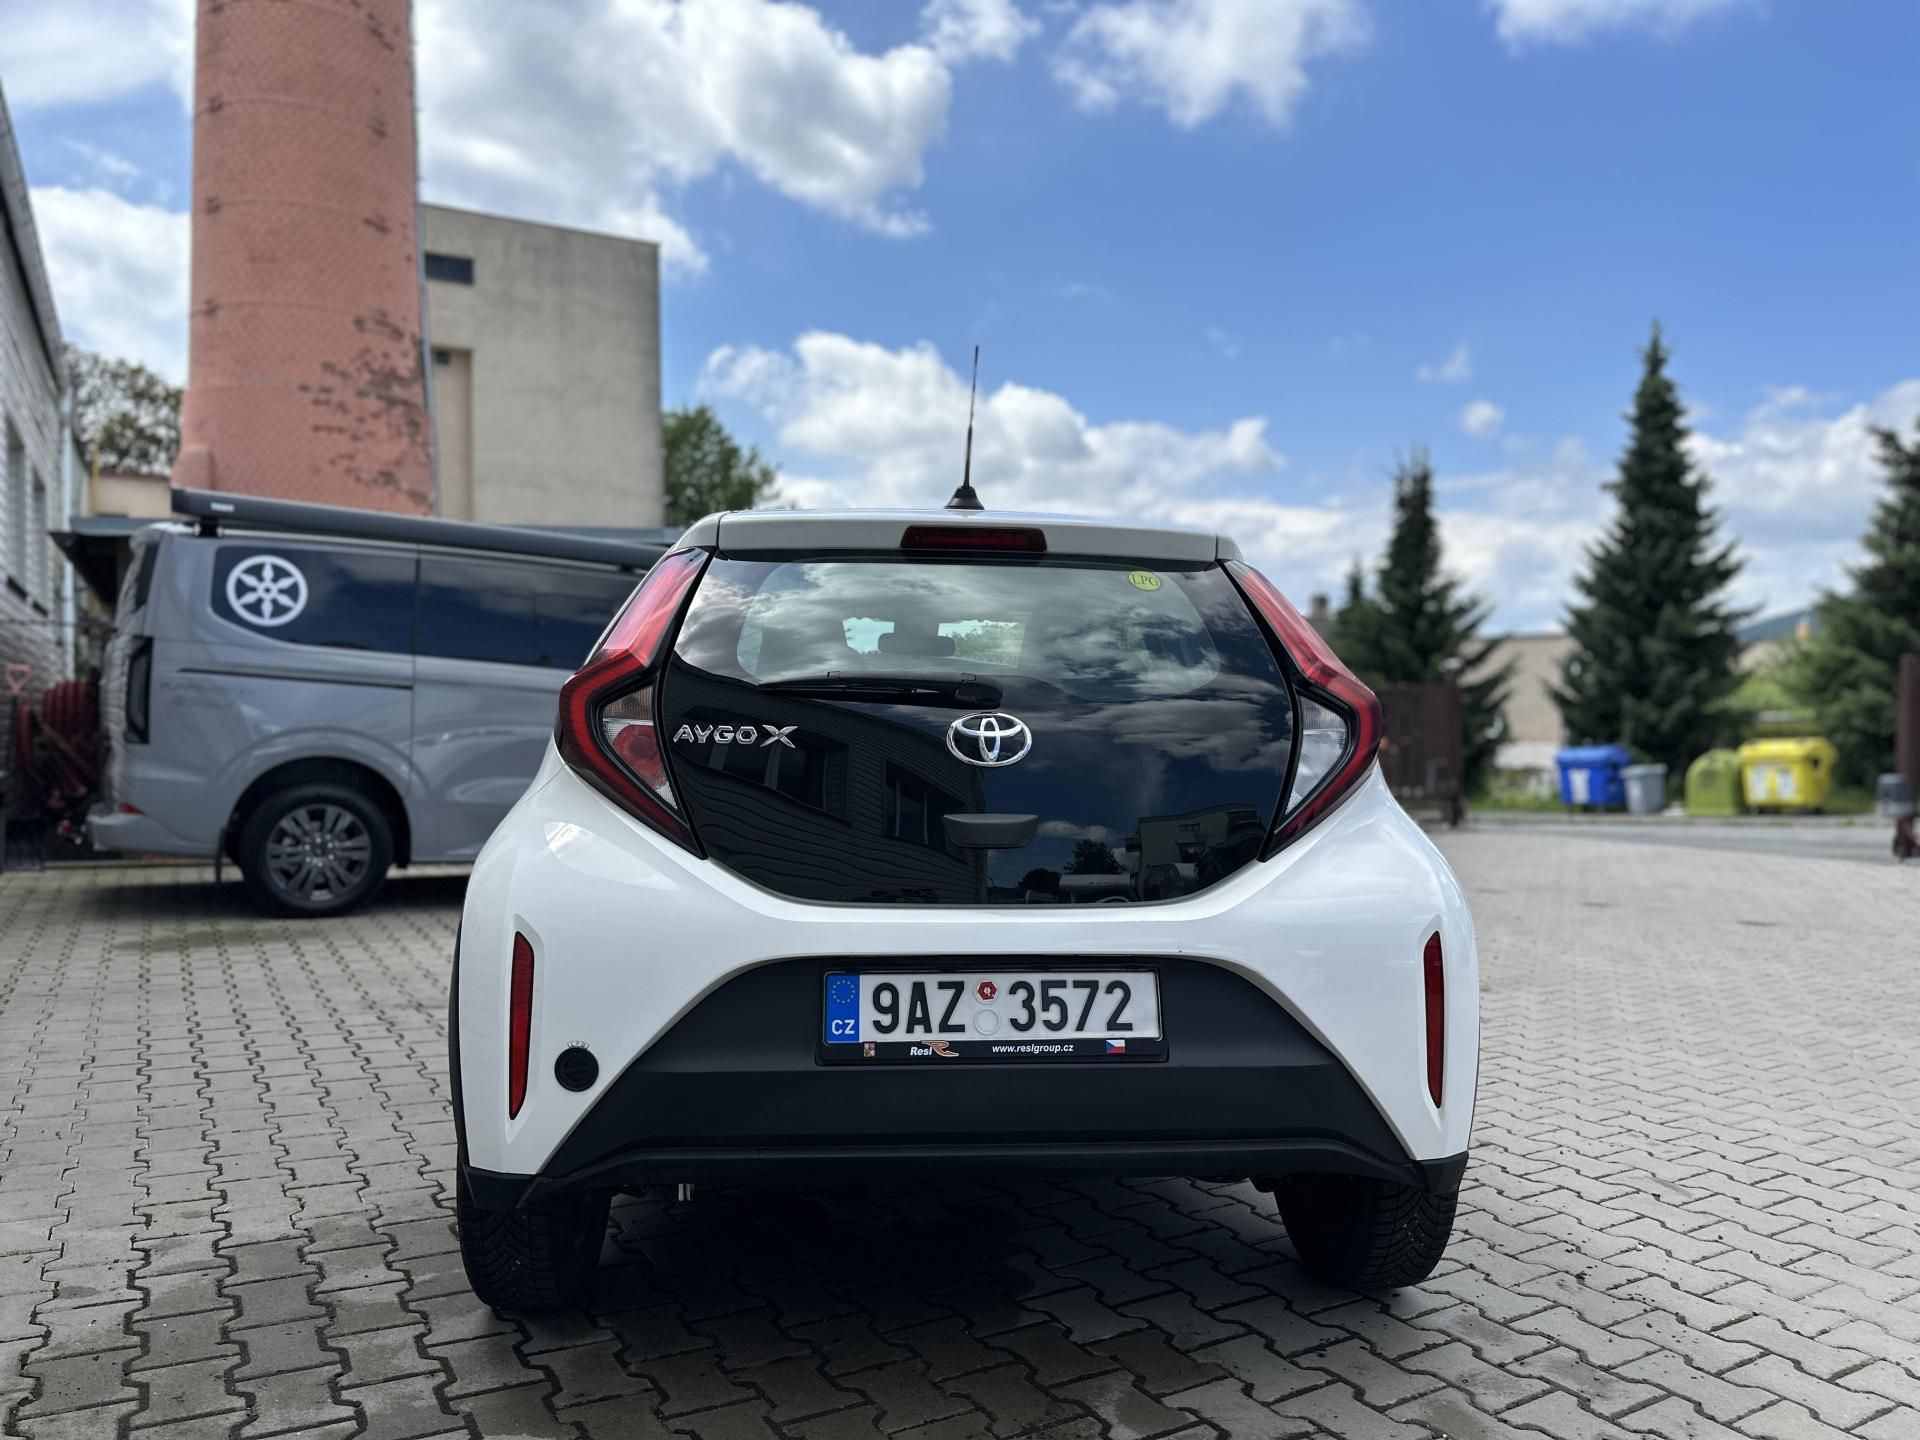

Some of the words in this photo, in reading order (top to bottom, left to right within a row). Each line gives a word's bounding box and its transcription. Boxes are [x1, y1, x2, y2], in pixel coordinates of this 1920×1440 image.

[1131, 574, 1159, 587] LPG
[673, 724, 758, 744] AYGO
[760, 724, 799, 749] X
[872, 981, 966, 1034] 9AZ
[1008, 980, 1133, 1032] 3572
[831, 1019, 855, 1035] CZ
[992, 1043, 1074, 1054] www.reslgroup.cz
